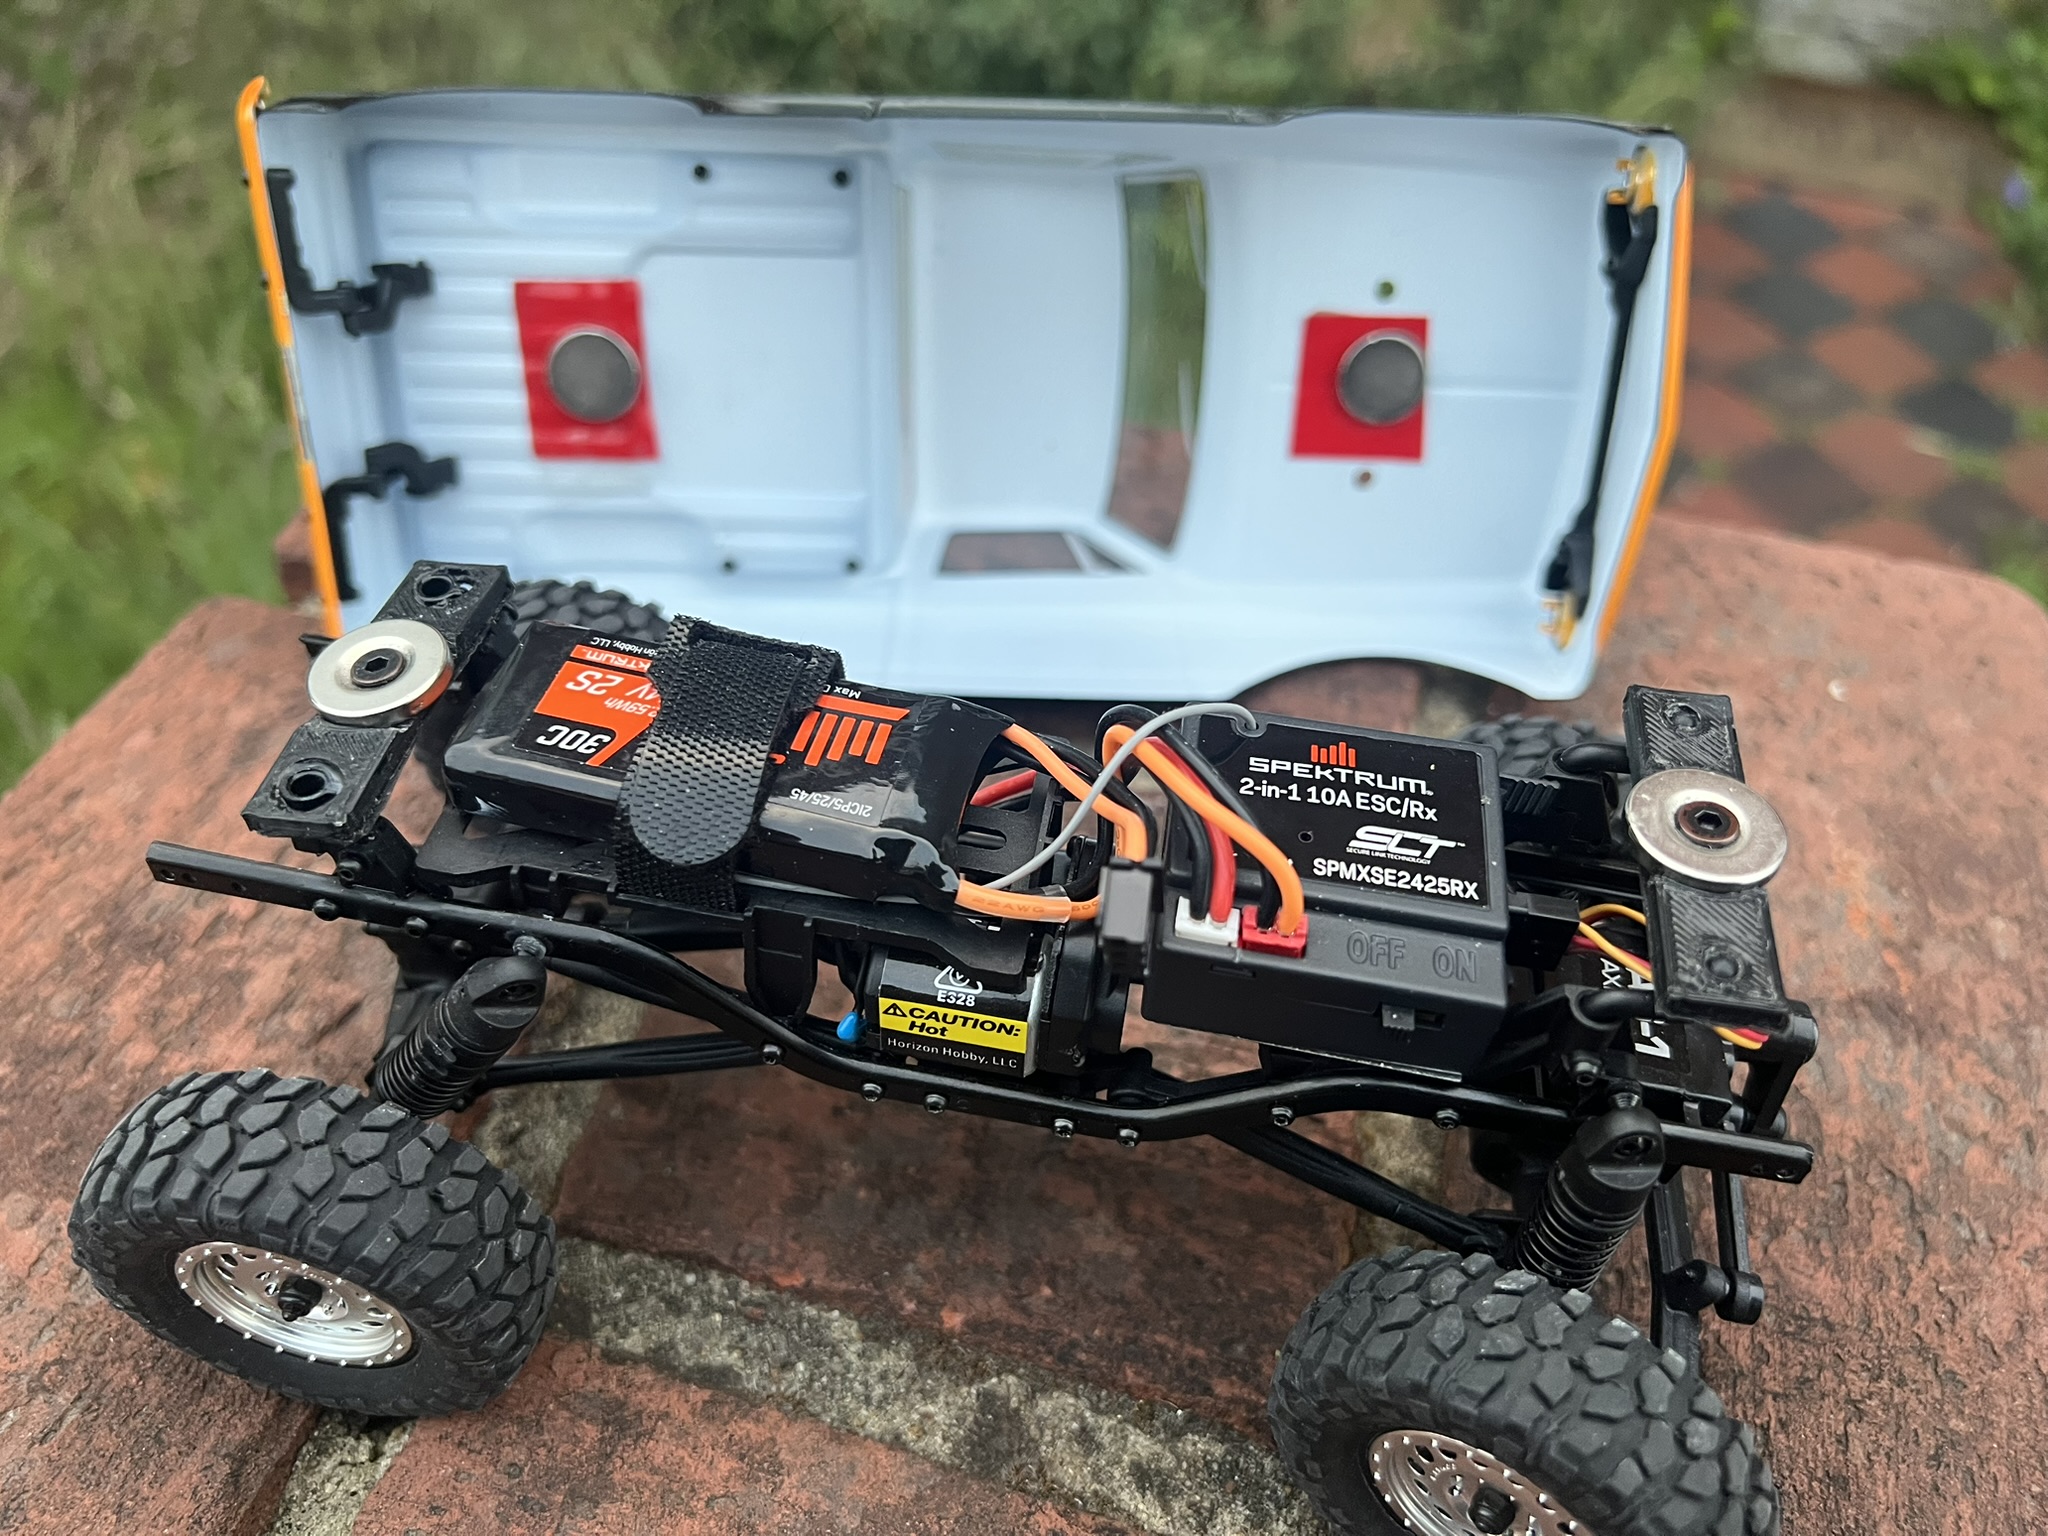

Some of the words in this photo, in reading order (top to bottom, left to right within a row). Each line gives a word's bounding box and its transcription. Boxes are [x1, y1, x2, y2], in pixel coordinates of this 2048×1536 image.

[590, 636, 611, 647] LLC
[565, 669, 625, 696] 2S
[834, 685, 862, 699] Max
[535, 724, 612, 754] 30C
[1249, 757, 1431, 795] SPEKTRUM
[1239, 778, 1301, 802] 2-in-1
[1306, 786, 1352, 808] 10A
[1355, 791, 1438, 822] ESC/Rx
[1313, 858, 1480, 901] SPMXSE2425RX
[1347, 929, 1406, 969] OFF
[1432, 945, 1477, 982] ON
[908, 1007, 1021, 1037] CAUTION:
[908, 1021, 949, 1037] Hot
[887, 1037, 939, 1054] Horizon
[942, 1046, 989, 1064] Hobby,
[992, 1056, 1018, 1069] LLC
